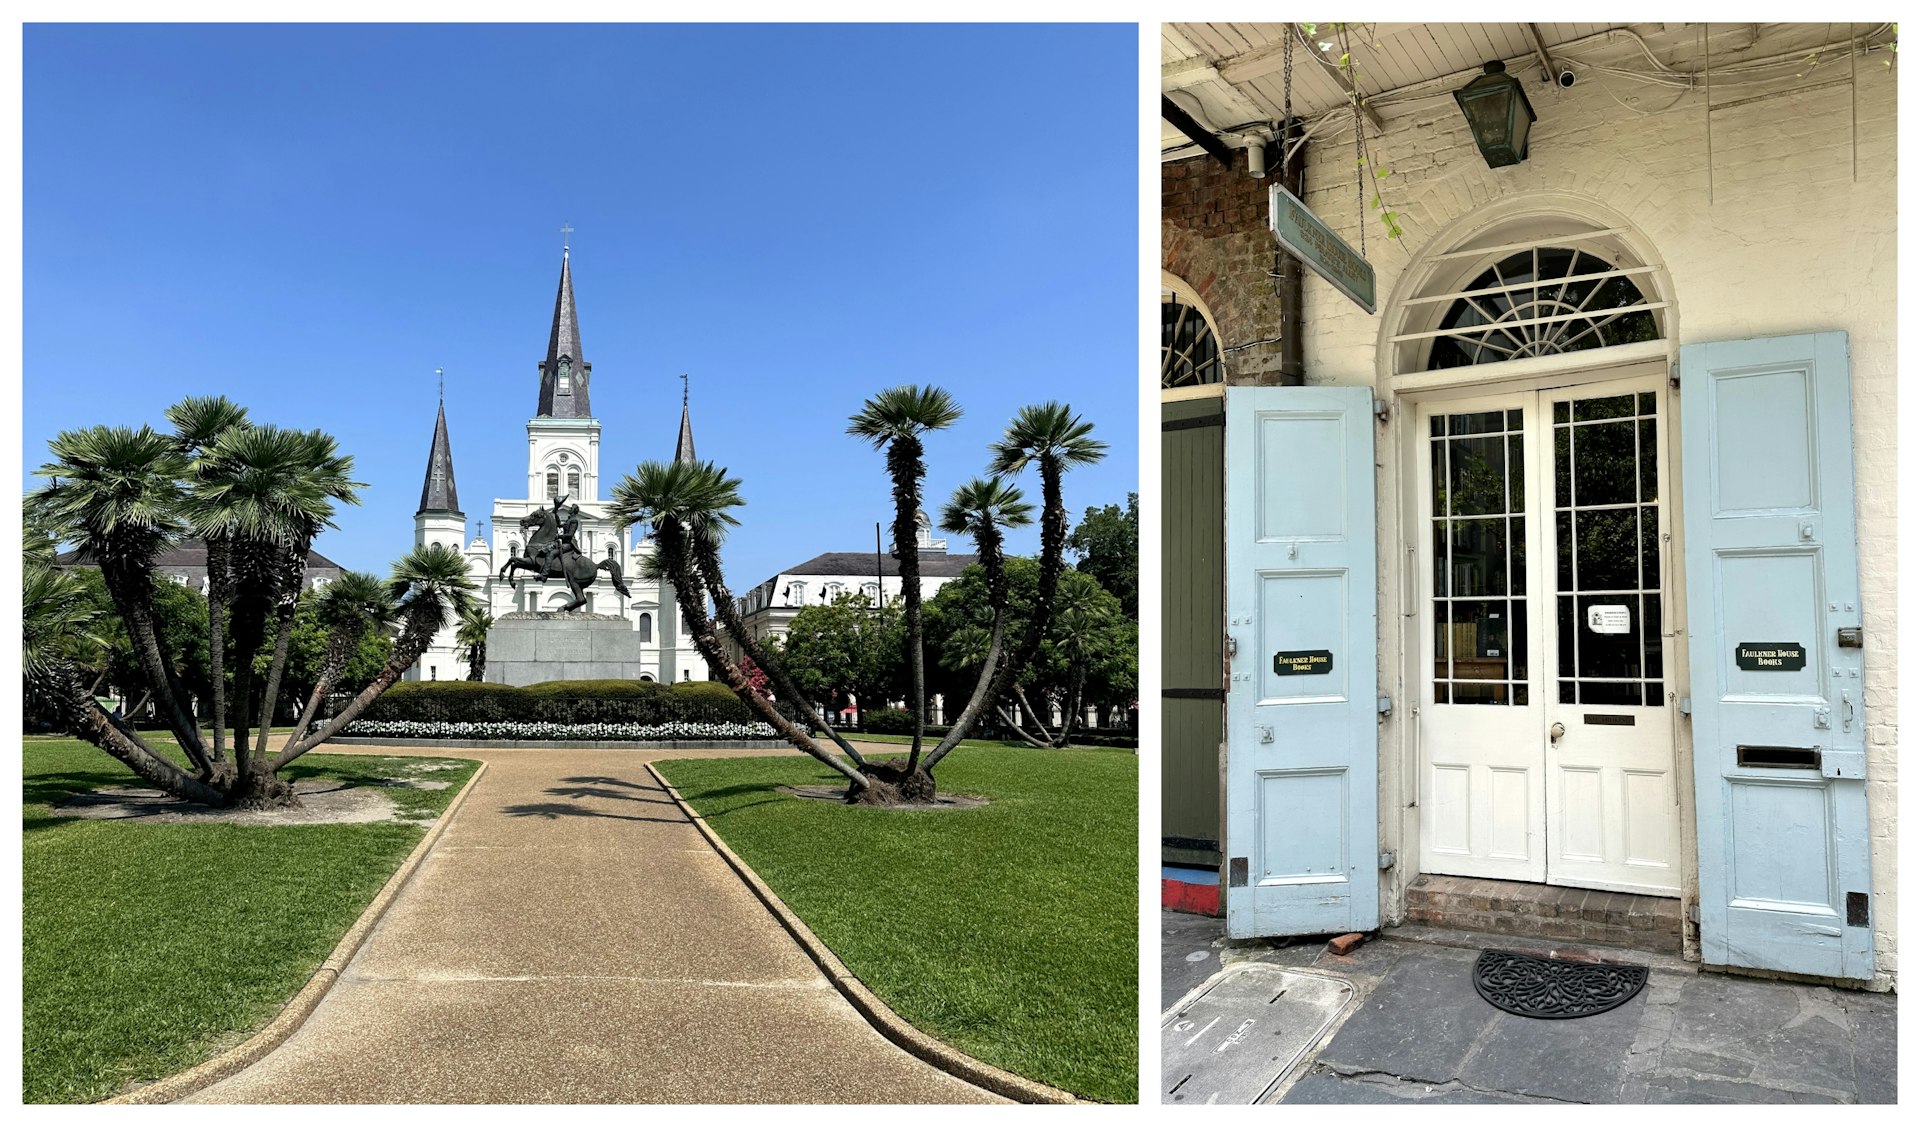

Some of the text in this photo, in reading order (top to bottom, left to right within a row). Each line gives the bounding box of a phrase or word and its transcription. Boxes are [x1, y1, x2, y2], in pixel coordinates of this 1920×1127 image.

[1742, 649, 1799, 657] FAULKNER HOUSE
[1279, 655, 1327, 664] FAULKNER HOUSE
